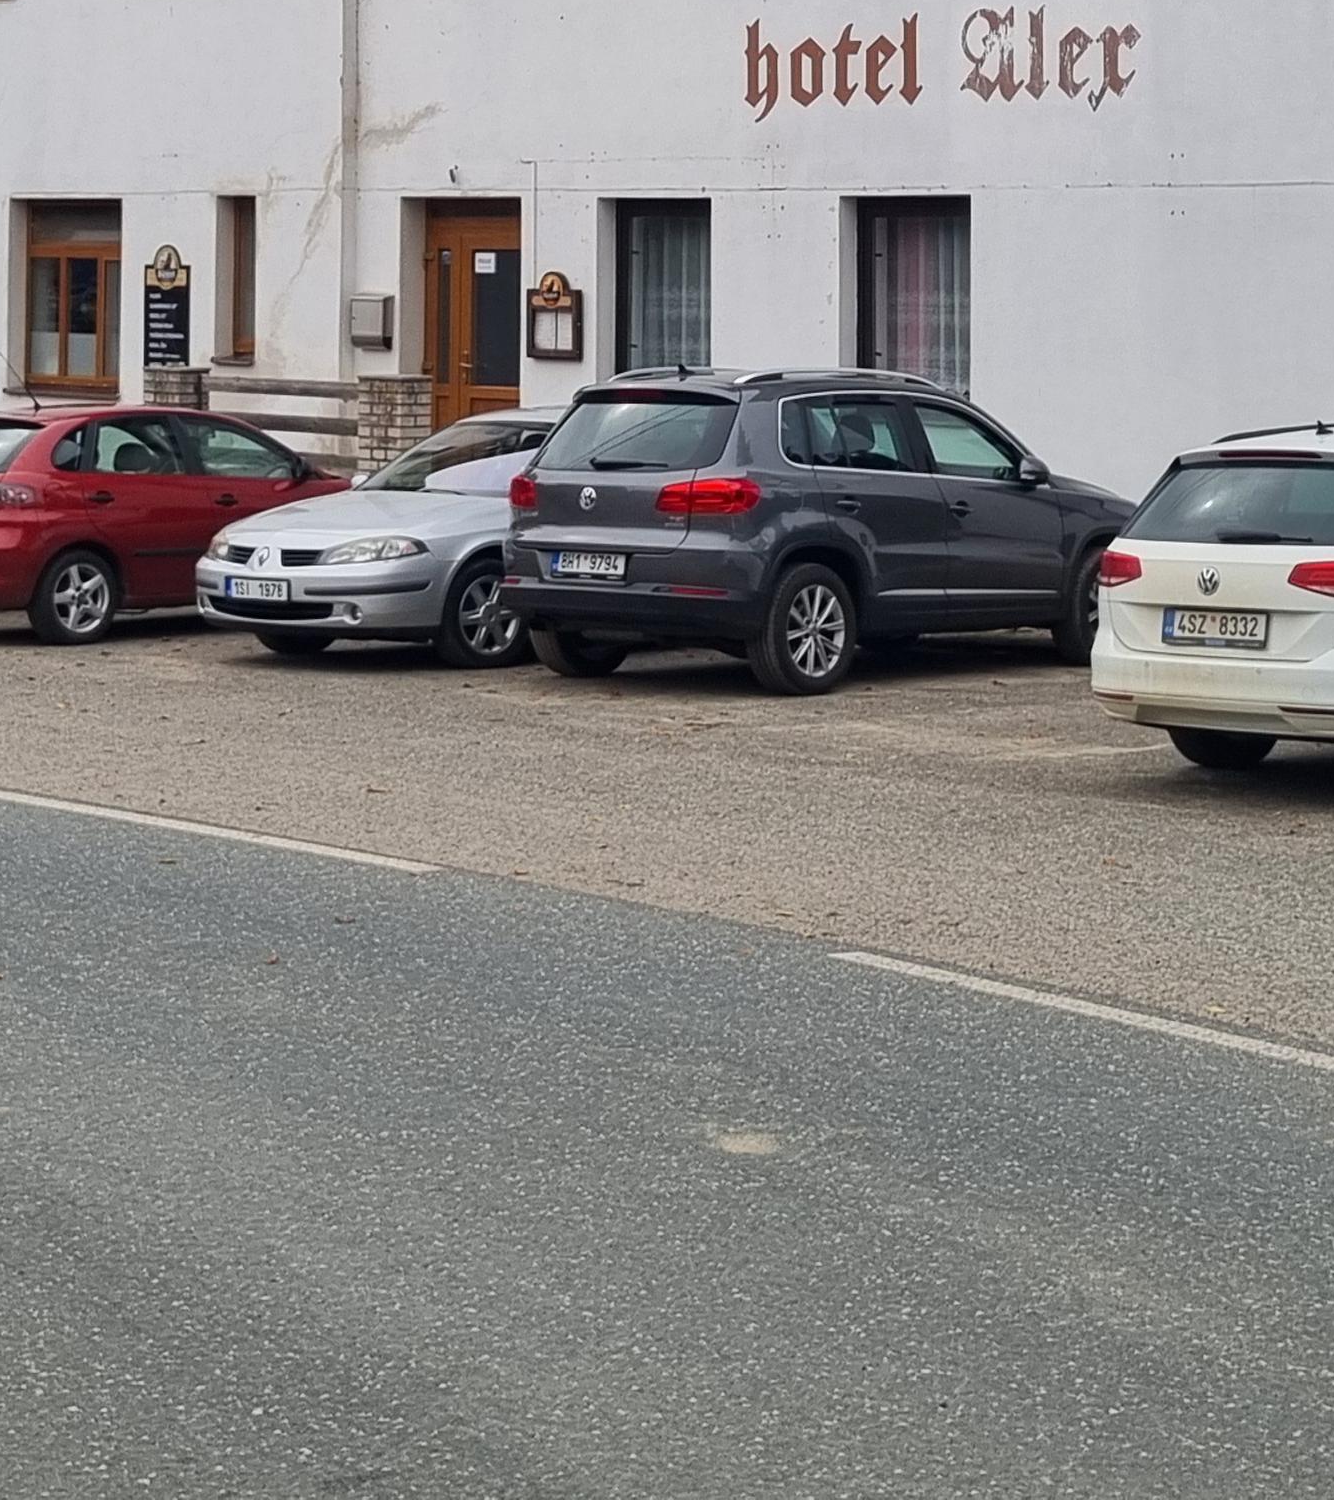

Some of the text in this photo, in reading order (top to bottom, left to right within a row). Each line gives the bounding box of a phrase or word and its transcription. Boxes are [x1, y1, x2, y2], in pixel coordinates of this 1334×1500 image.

[744, 12, 923, 123] hotel
[589, 554, 619, 572] 9794
[1178, 613, 1258, 637] 4SZ 8332
